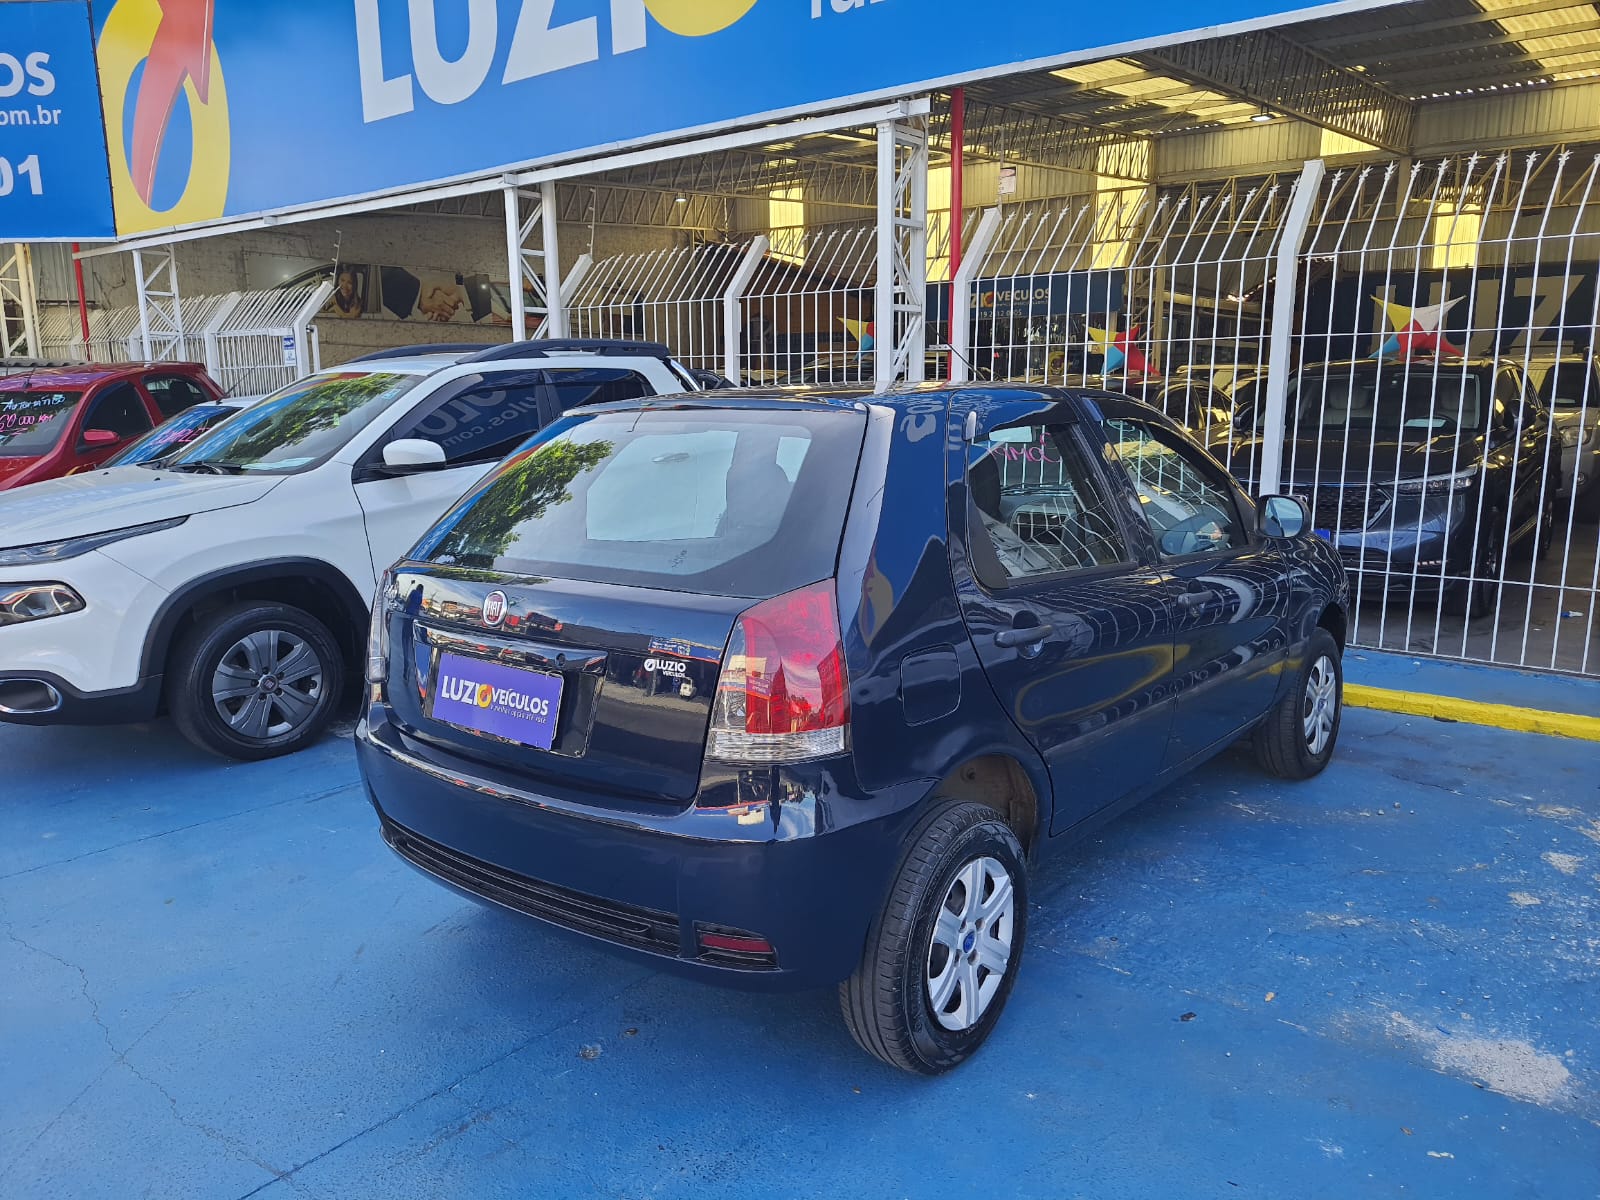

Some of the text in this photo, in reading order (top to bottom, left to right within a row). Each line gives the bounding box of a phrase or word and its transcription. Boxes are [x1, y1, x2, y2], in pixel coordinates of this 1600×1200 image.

[656, 660, 687, 673] LUZIO
[441, 675, 493, 709] LUZIO
[492, 687, 549, 716] VEÍCULOS
